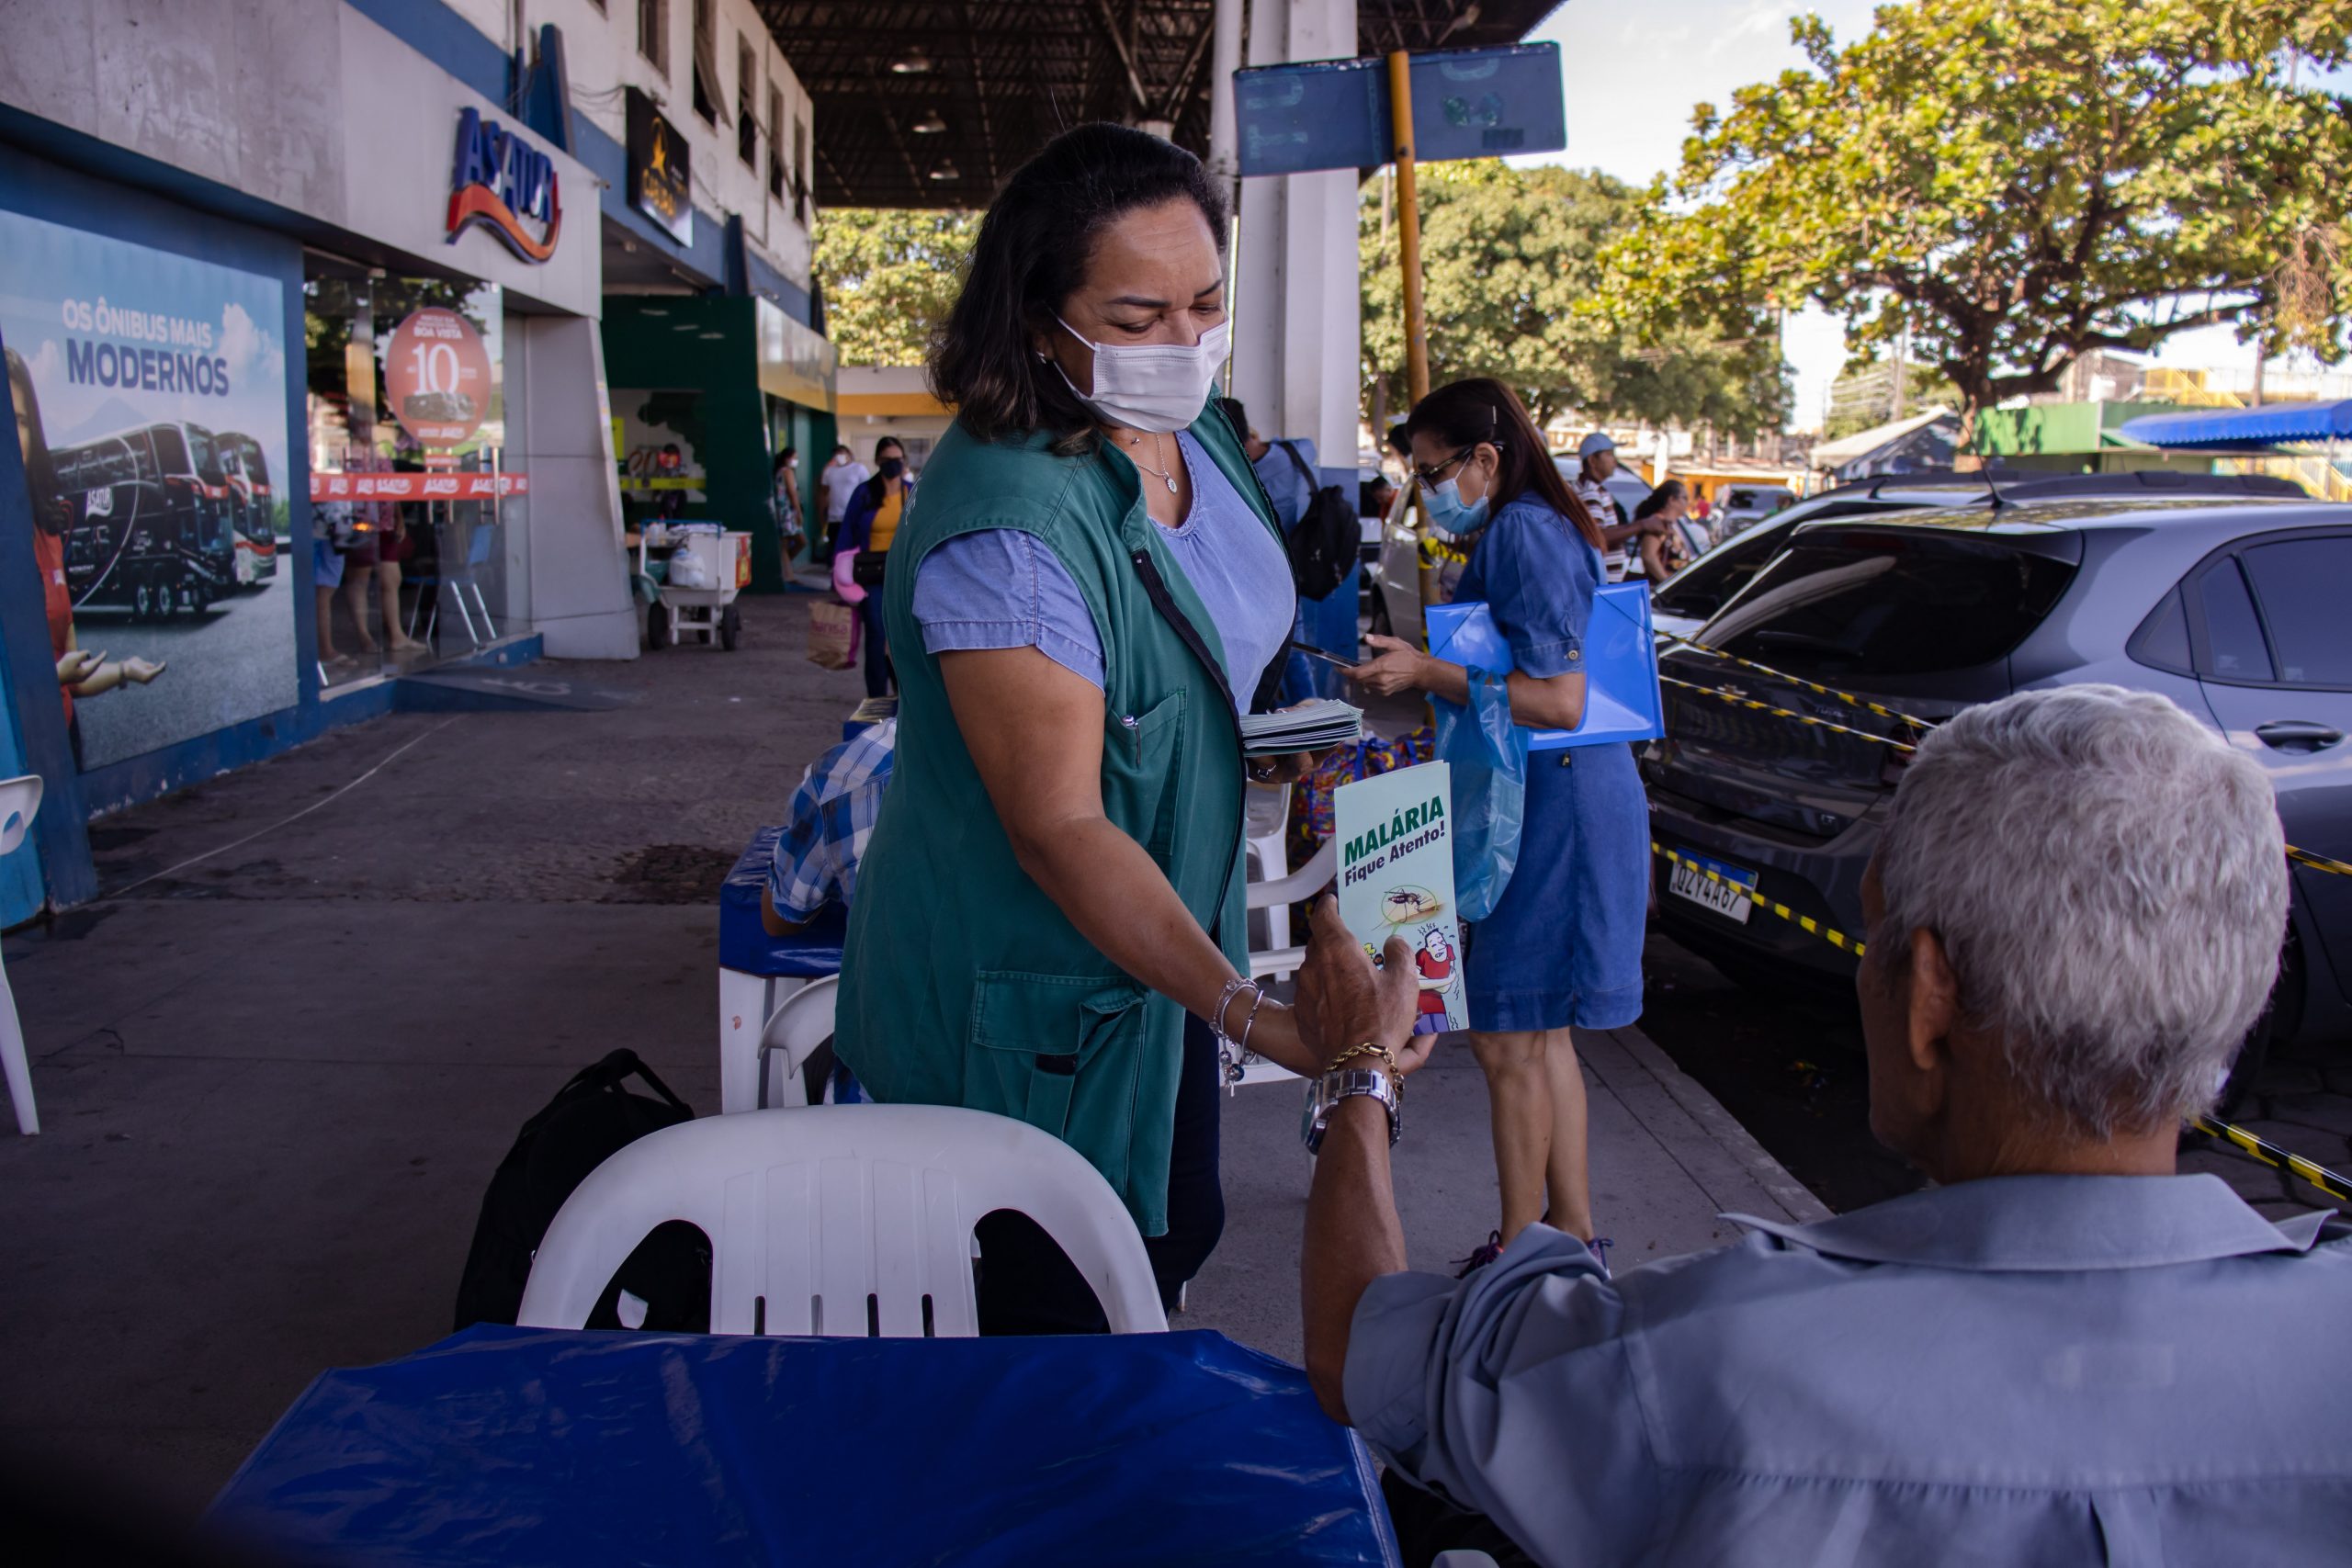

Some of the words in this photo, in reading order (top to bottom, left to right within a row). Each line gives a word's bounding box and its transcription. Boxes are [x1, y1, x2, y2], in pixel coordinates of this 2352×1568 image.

[62, 299, 93, 333] OS
[95, 296, 168, 344] ÔNIBUS
[170, 317, 213, 349] MAIS
[413, 327, 435, 338] BOA
[435, 328, 463, 339] VISTA
[67, 338, 229, 397] MODERNOS
[412, 342, 459, 396] 10
[1345, 795, 1444, 867] MALÁRIA
[1345, 856, 1385, 887] Fique
[1389, 820, 1445, 863] Atento!
